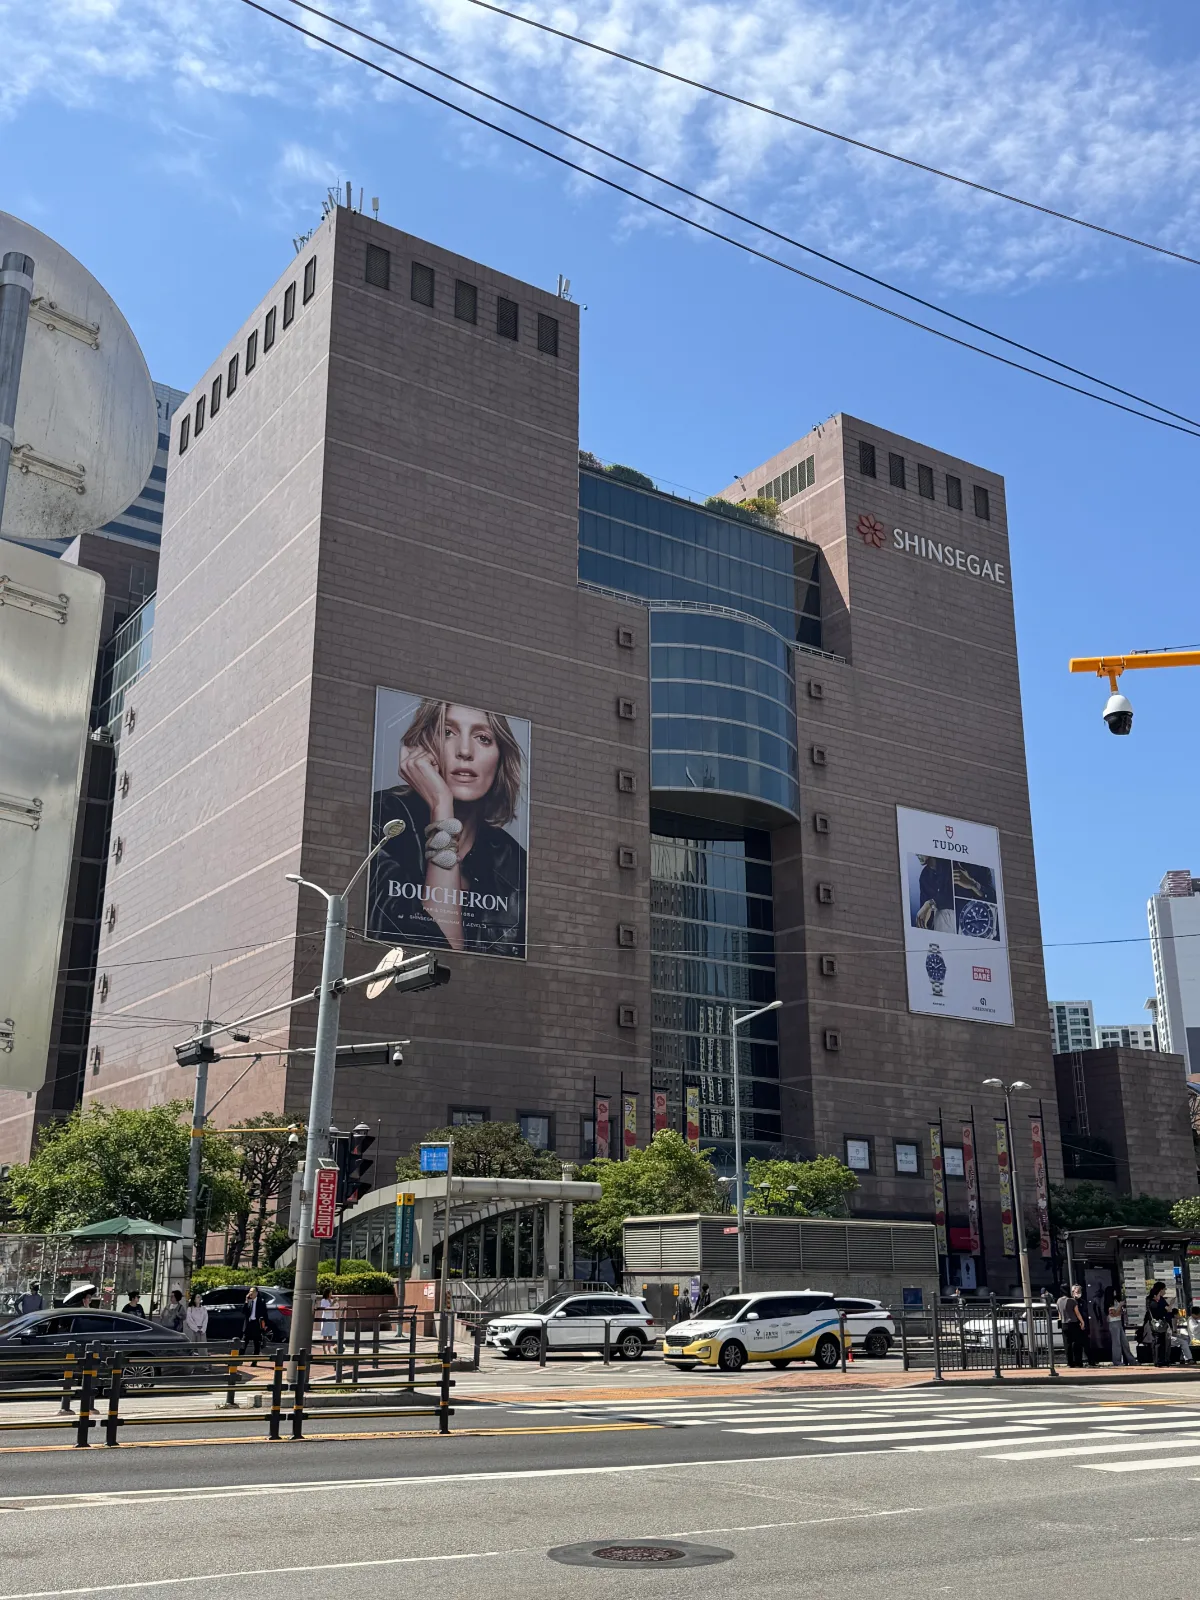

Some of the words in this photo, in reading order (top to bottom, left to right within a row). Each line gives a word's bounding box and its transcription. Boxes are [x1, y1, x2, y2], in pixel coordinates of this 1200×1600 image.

[893, 528, 1006, 585] SHINSEGAE
[932, 839, 969, 855] TUDOR
[388, 879, 509, 912] BOUCHERON
[973, 972, 991, 981] DARE
[316, 1172, 335, 1236] 무단횡단금지
